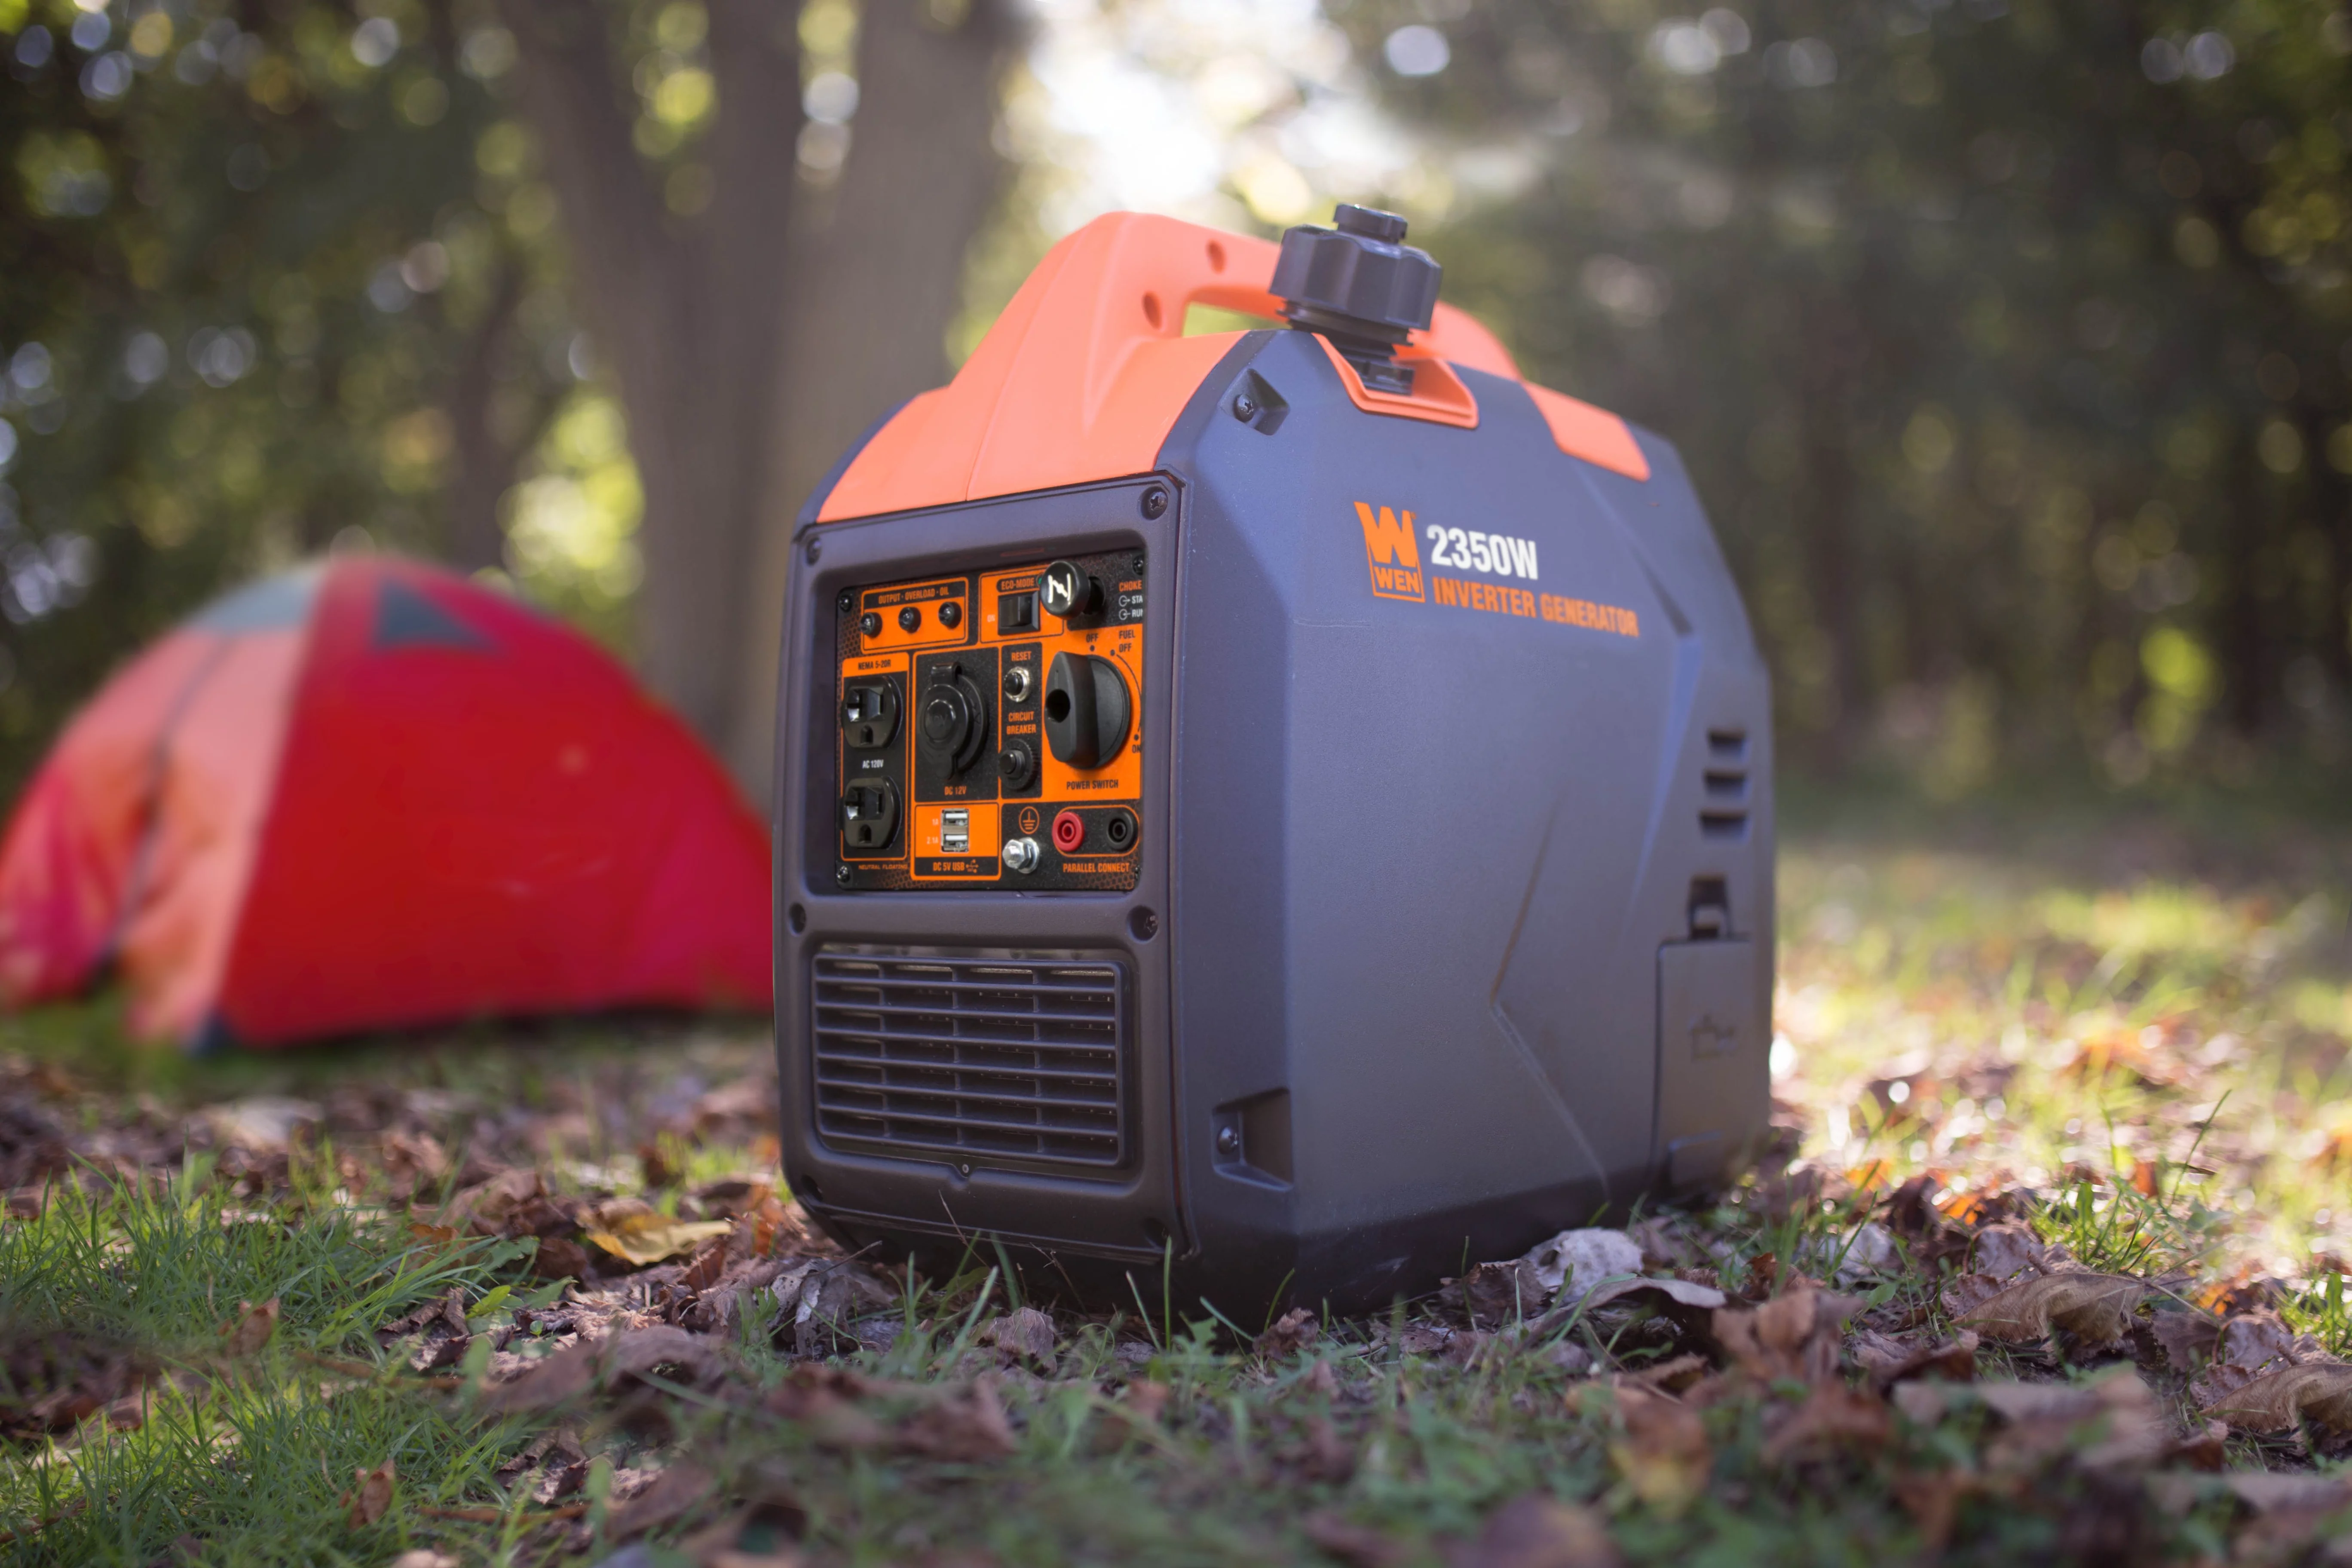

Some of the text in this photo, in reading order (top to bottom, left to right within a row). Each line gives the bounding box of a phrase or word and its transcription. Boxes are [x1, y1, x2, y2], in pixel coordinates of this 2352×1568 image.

[1427, 524, 1538, 580] 2350W
[1001, 577, 1035, 590] ECO-MODE
[1374, 567, 1420, 593] WEN
[1119, 580, 1142, 592] CHOKE
[879, 587, 949, 604] OUTPUT OVERLOAD OIL
[1432, 576, 1639, 637] INVERTER GENERATOR
[1086, 633, 1099, 643] OFF
[1119, 629, 1135, 639] FUEL
[1119, 643, 1131, 652] OFF
[1011, 651, 1032, 662] RESET
[858, 659, 891, 670] NEMA 5-20R
[1008, 711, 1034, 722] CIRCUIT
[1007, 724, 1036, 735] BREAKER
[862, 759, 884, 769] AC 120V
[1066, 779, 1119, 790] POWER SWITCH
[944, 786, 967, 795] DC 12V
[927, 836, 939, 845] 2.1A
[933, 862, 942, 871] DC
[943, 862, 951, 871] 5V
[952, 862, 965, 871] USB
[1063, 862, 1130, 873] PARALLEL CONNECT
